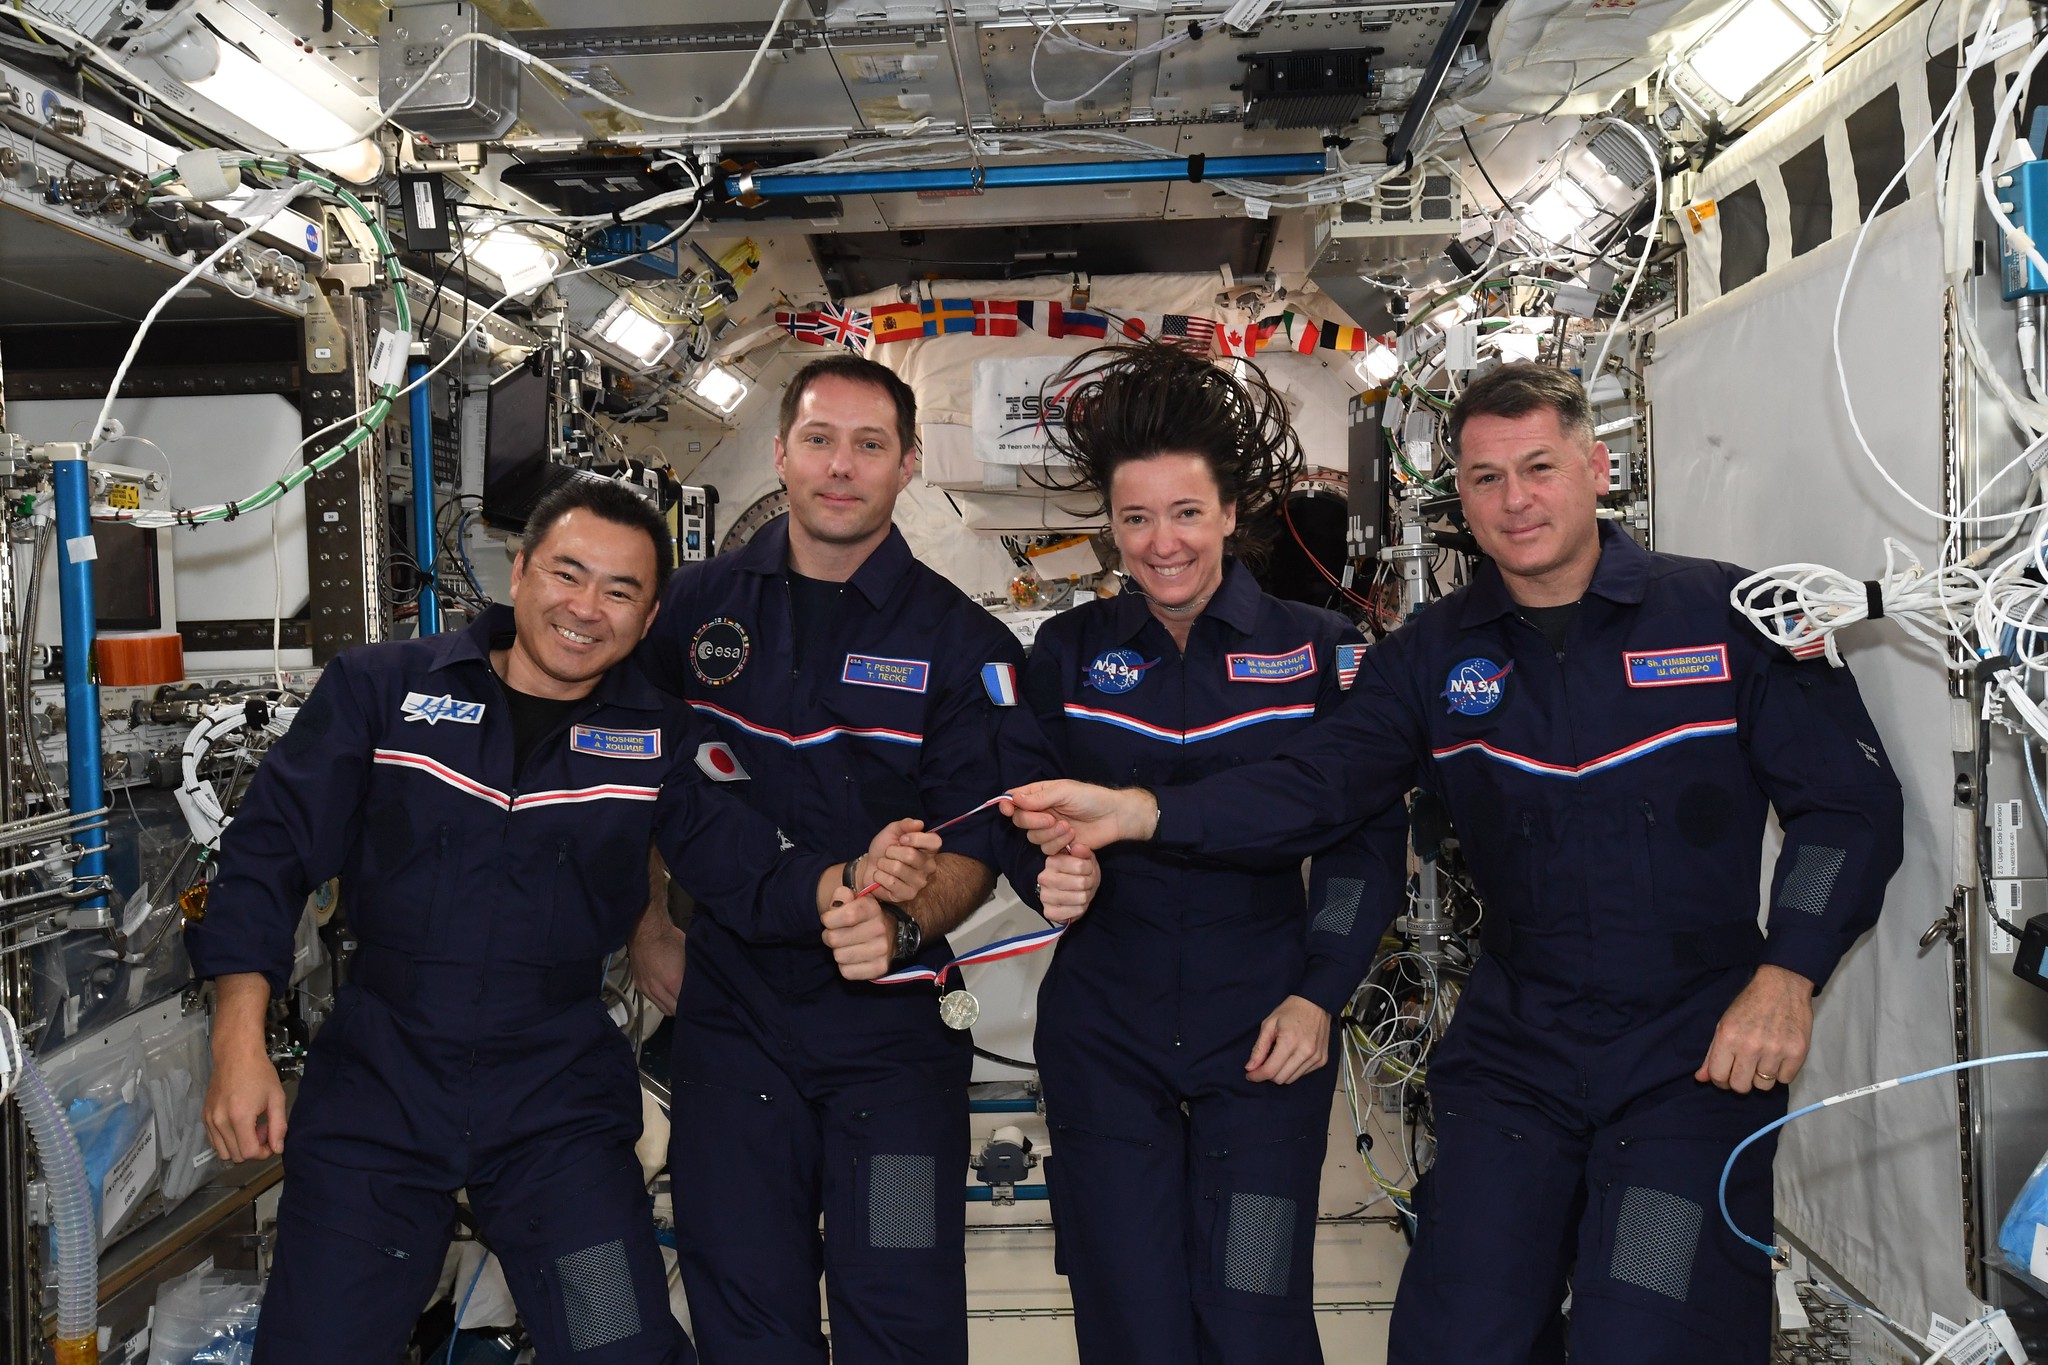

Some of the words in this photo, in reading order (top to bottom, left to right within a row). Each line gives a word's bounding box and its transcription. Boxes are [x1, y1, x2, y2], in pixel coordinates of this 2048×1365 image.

[26, 92, 35, 115] 8
[714, 646, 741, 659] esa
[1646, 659, 1661, 668] Sh.
[1662, 654, 1719, 667] KIMBROUGH
[865, 662, 872, 670] T.
[874, 663, 914, 675] PESQUET
[1094, 660, 1138, 680] NASA
[1656, 668, 1669, 676] Ш.
[1670, 664, 1710, 675] КИМБРО
[878, 673, 907, 683] ПЕСКЕ
[1450, 680, 1500, 693] NASA
[408, 696, 482, 721] JAXA
[594, 733, 603, 741] A.
[605, 735, 644, 744] HOSHIDE
[605, 743, 644, 752] ХОШИДЕ
